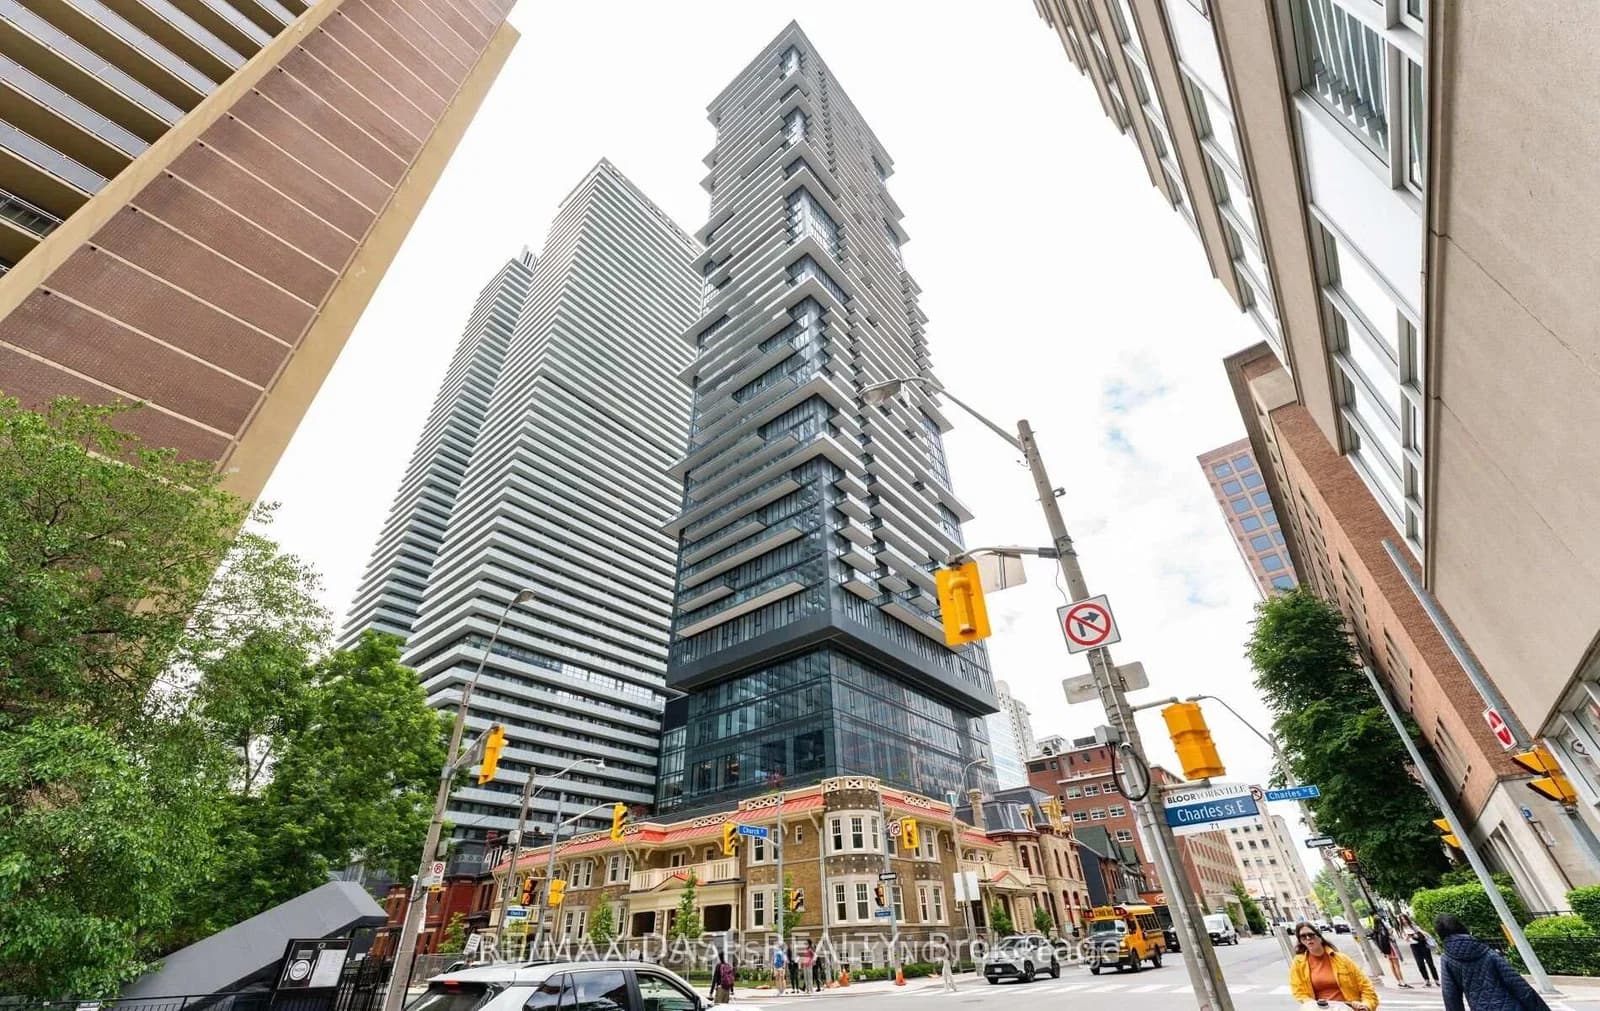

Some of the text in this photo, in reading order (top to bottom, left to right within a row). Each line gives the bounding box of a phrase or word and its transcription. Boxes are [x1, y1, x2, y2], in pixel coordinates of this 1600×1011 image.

[1268, 790, 1302, 800] Charles
[1308, 787, 1316, 795] E
[1177, 800, 1247, 822] Charles St E
[742, 826, 760, 835] Church
